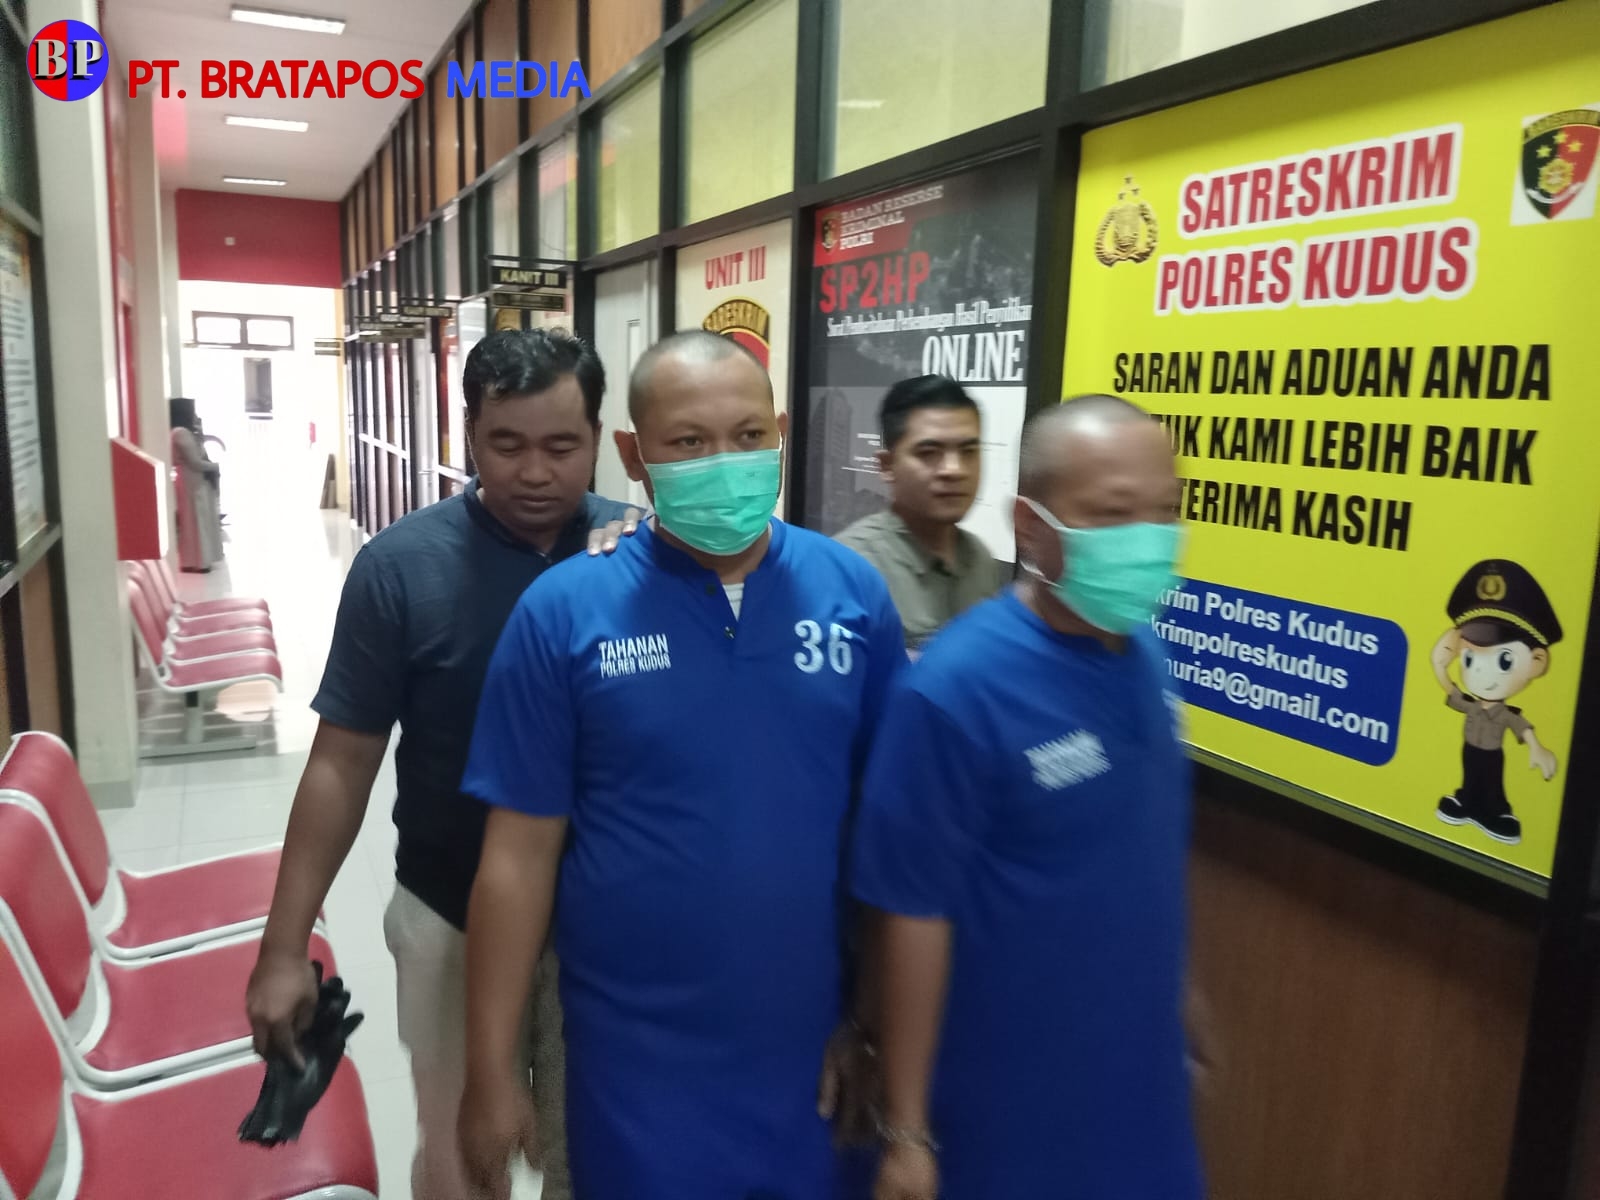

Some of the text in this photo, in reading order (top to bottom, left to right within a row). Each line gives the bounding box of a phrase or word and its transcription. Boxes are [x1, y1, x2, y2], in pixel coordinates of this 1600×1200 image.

[1182, 131, 1454, 234] SATRESKRIM
[500, 269, 542, 285] KANIT
[705, 245, 767, 290] UNIT III
[819, 250, 931, 314] SP2HP
[1160, 226, 1470, 310] POLRES KUDUS
[921, 330, 1025, 382] ONLINE
[1113, 344, 1552, 401] SARAN DAN ADUAN ANDA
[1208, 416, 1294, 465] KAMI
[1302, 420, 1413, 475] LEBIH
[1420, 425, 1539, 486] BAIK
[1291, 489, 1413, 552] KASIH
[598, 633, 669, 663] TAHANAN
[794, 619, 853, 676] 36
[1204, 591, 1281, 633] Polres
[1287, 610, 1379, 656] Kudus
[637, 652, 672, 673] KUDUS
